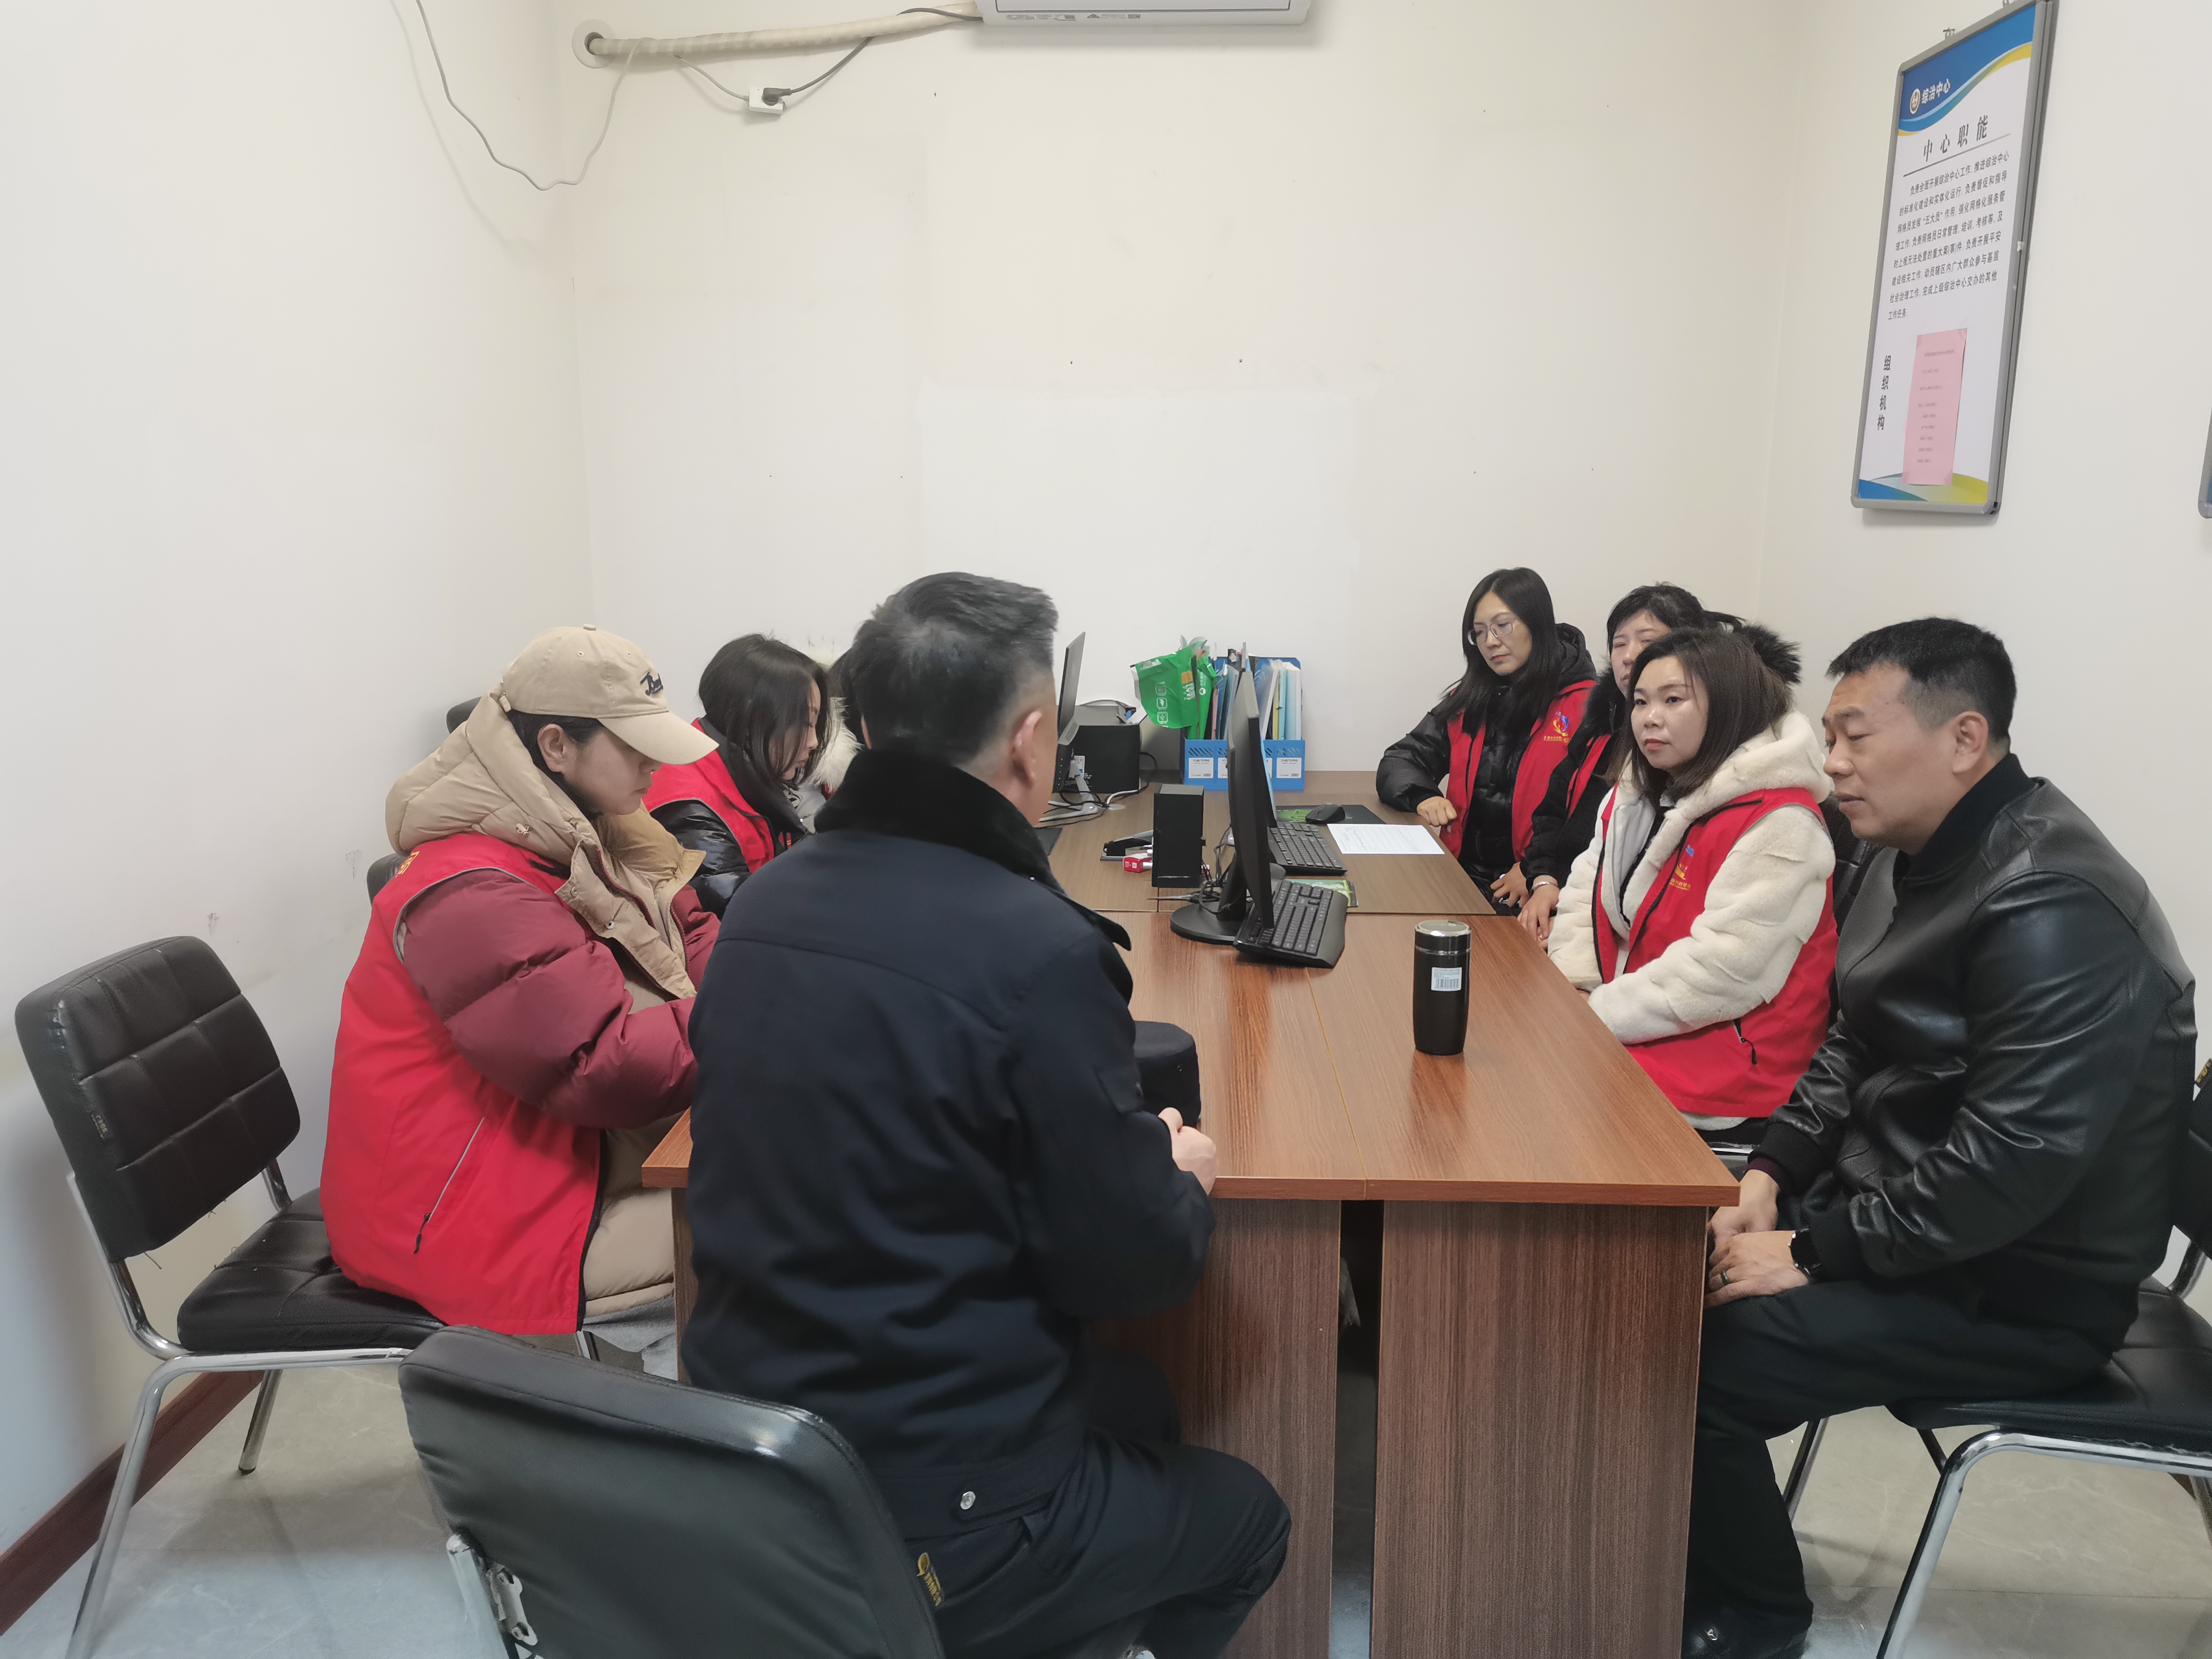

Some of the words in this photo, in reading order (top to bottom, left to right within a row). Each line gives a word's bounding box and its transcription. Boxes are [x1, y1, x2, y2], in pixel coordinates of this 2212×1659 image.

[1922, 78, 1951, 104] 综治中心
[1923, 115, 1988, 162] 中心职能
[1877, 355, 1891, 431] 组织机构
